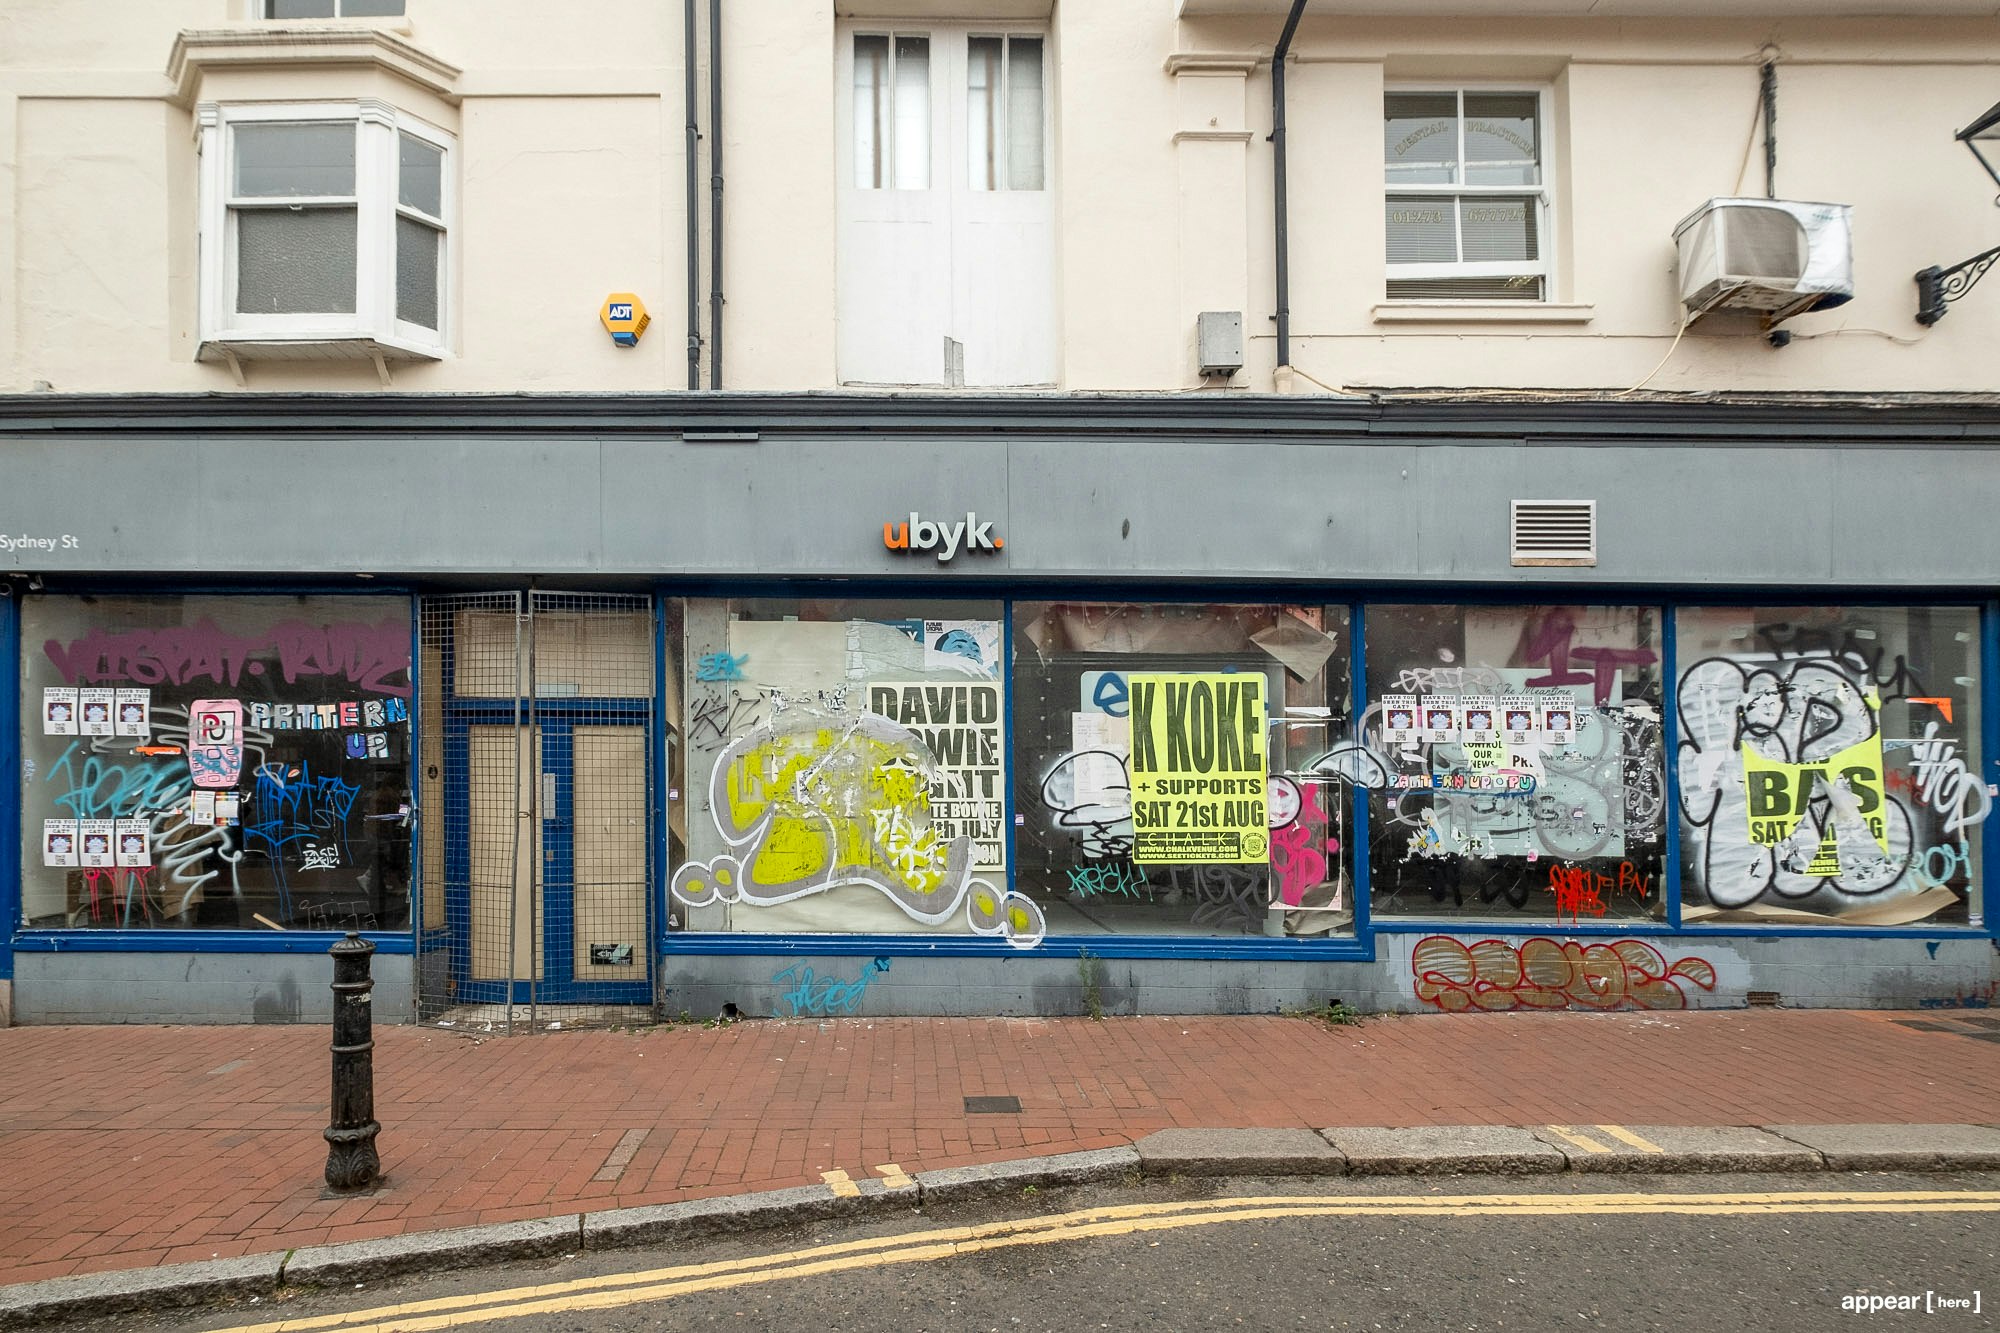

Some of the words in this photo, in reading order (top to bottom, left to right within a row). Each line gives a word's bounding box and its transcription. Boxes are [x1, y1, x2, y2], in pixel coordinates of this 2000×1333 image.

[1395, 121, 1448, 155] DENTAL
[1393, 209, 1442, 223] 01273
[610, 306, 632, 318] ADT
[0, 533, 57, 552] Sydney
[61, 534, 79, 548] St
[883, 511, 1004, 561] ubyk.
[251, 698, 408, 730] PATTERN
[871, 687, 997, 724] DAVID
[1132, 682, 1158, 772] K
[1165, 680, 1262, 773] KOKE
[346, 732, 389, 759] UP
[1474, 750, 1492, 758] OUR
[1138, 782, 1150, 792] +
[1156, 779, 1262, 795] SUPPORTS
[1470, 775, 1491, 789] UP
[1508, 775, 1531, 789] PU
[1134, 801, 1171, 828] SAT
[1176, 801, 1219, 828] 21st
[1223, 800, 1264, 828] AUG
[1147, 833, 1227, 846] CHALK
[1752, 821, 1788, 844] SAT
